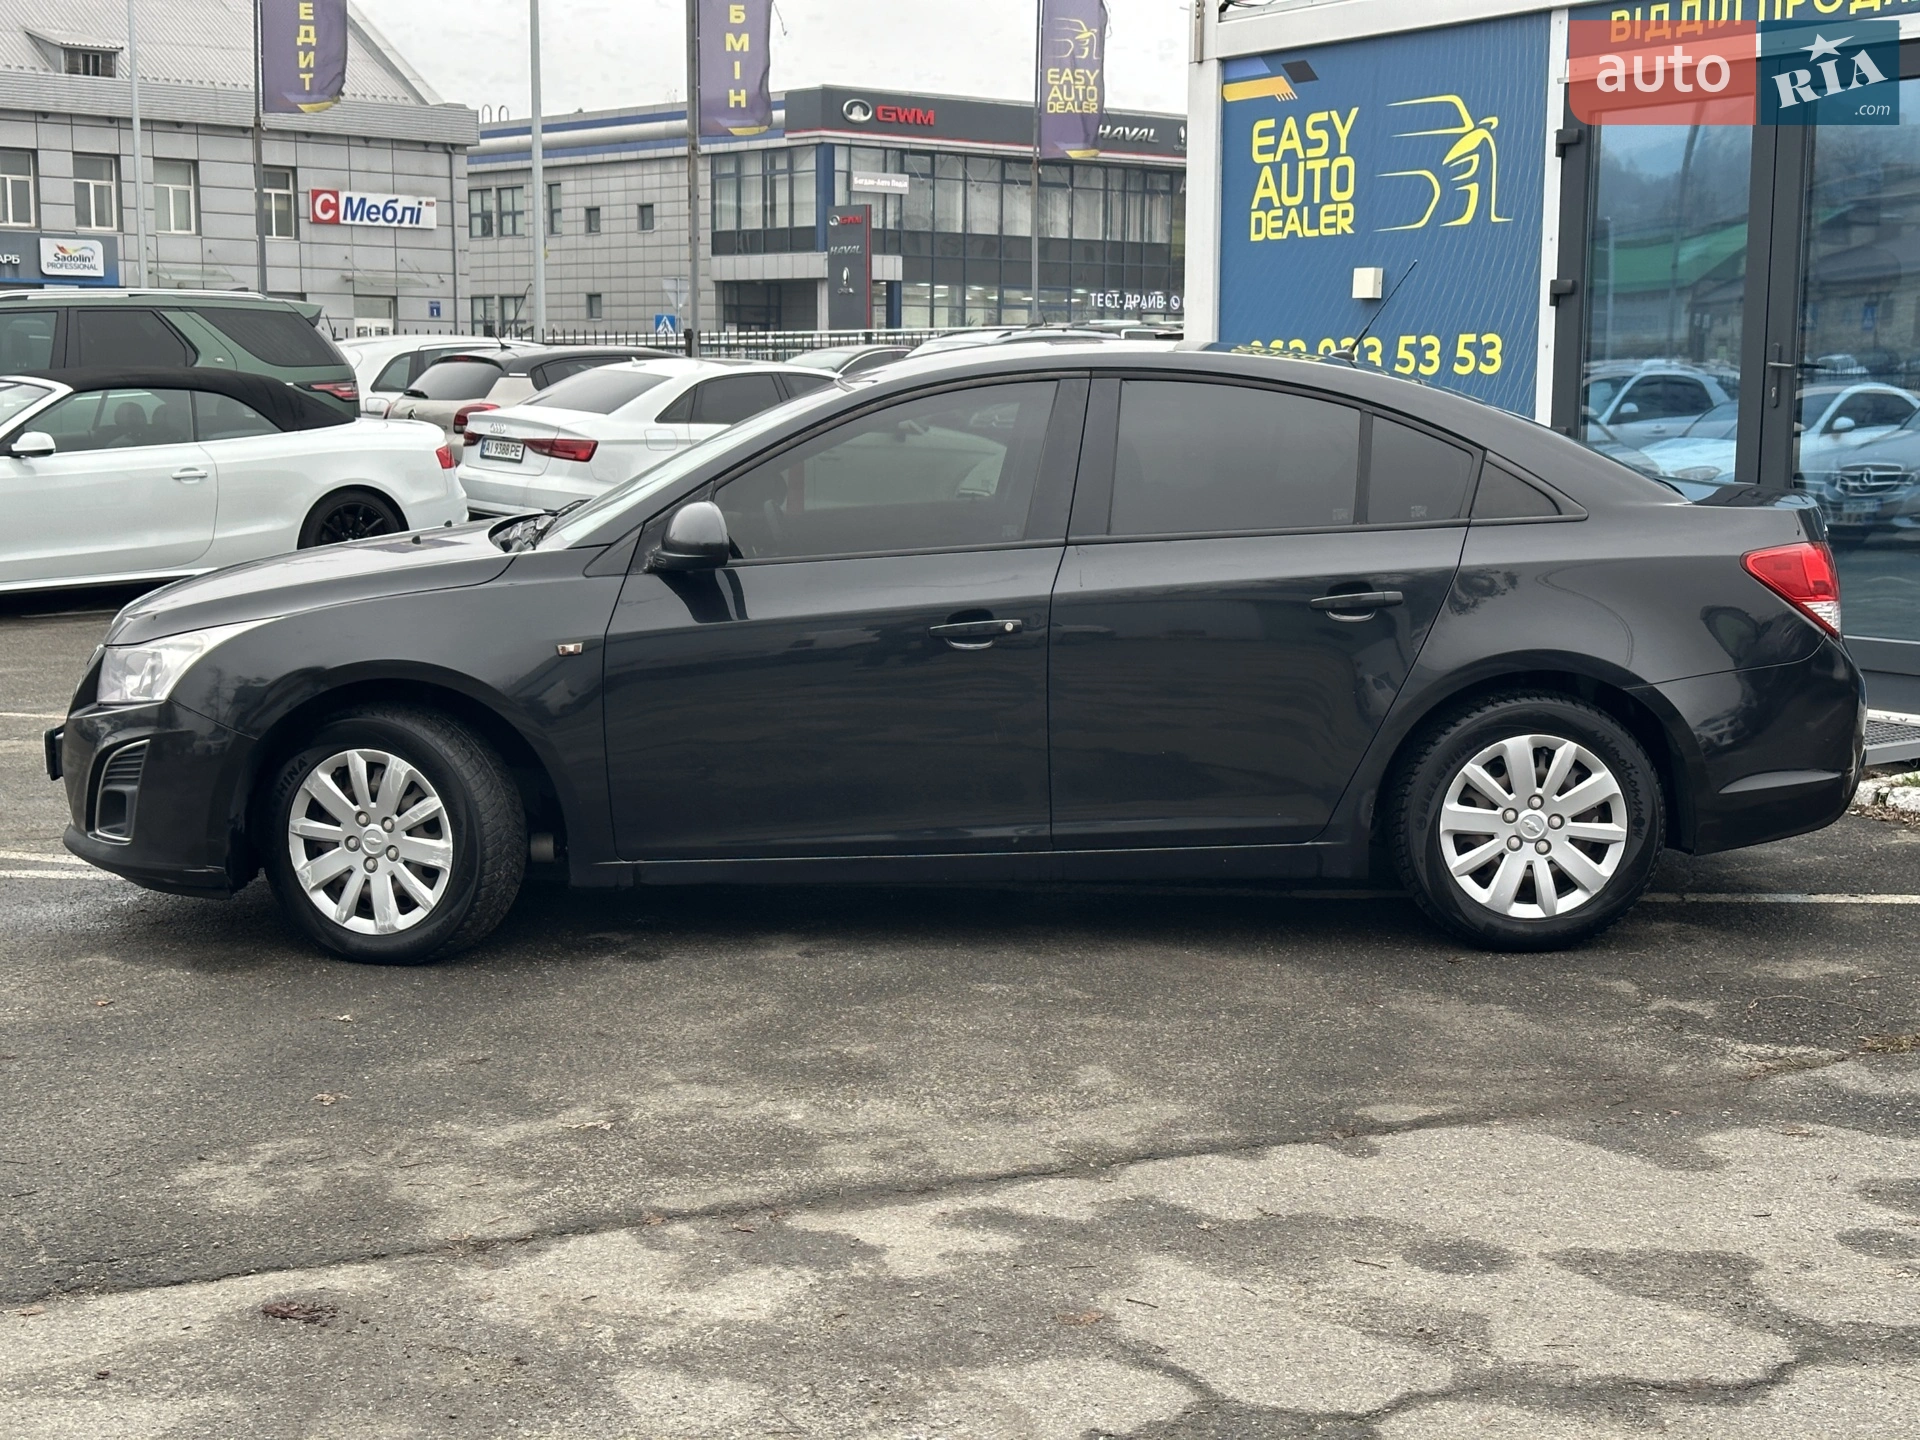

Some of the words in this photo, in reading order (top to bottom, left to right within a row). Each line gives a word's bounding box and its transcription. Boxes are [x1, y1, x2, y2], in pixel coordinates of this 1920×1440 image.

[1610, 0, 1742, 43] ВІДДІЛ
[725, 4, 749, 108] БМІН
[1047, 68, 1099, 85] EASY
[1048, 85, 1098, 102] AUTO
[876, 105, 935, 126] GWM
[1047, 101, 1098, 114] DEALER
[1098, 124, 1159, 143] HAVAL
[1252, 106, 1360, 164] EASY
[1251, 156, 1356, 210] AUTO
[342, 196, 423, 226] Меблі
[1250, 202, 1356, 242] DEALER
[54, 252, 91, 263] Sadolin
[830, 244, 862, 255] HAVAL
[46, 261, 98, 271] PROFESSIONAL
[1394, 335, 1441, 376] 53
[1453, 333, 1502, 375] 53
